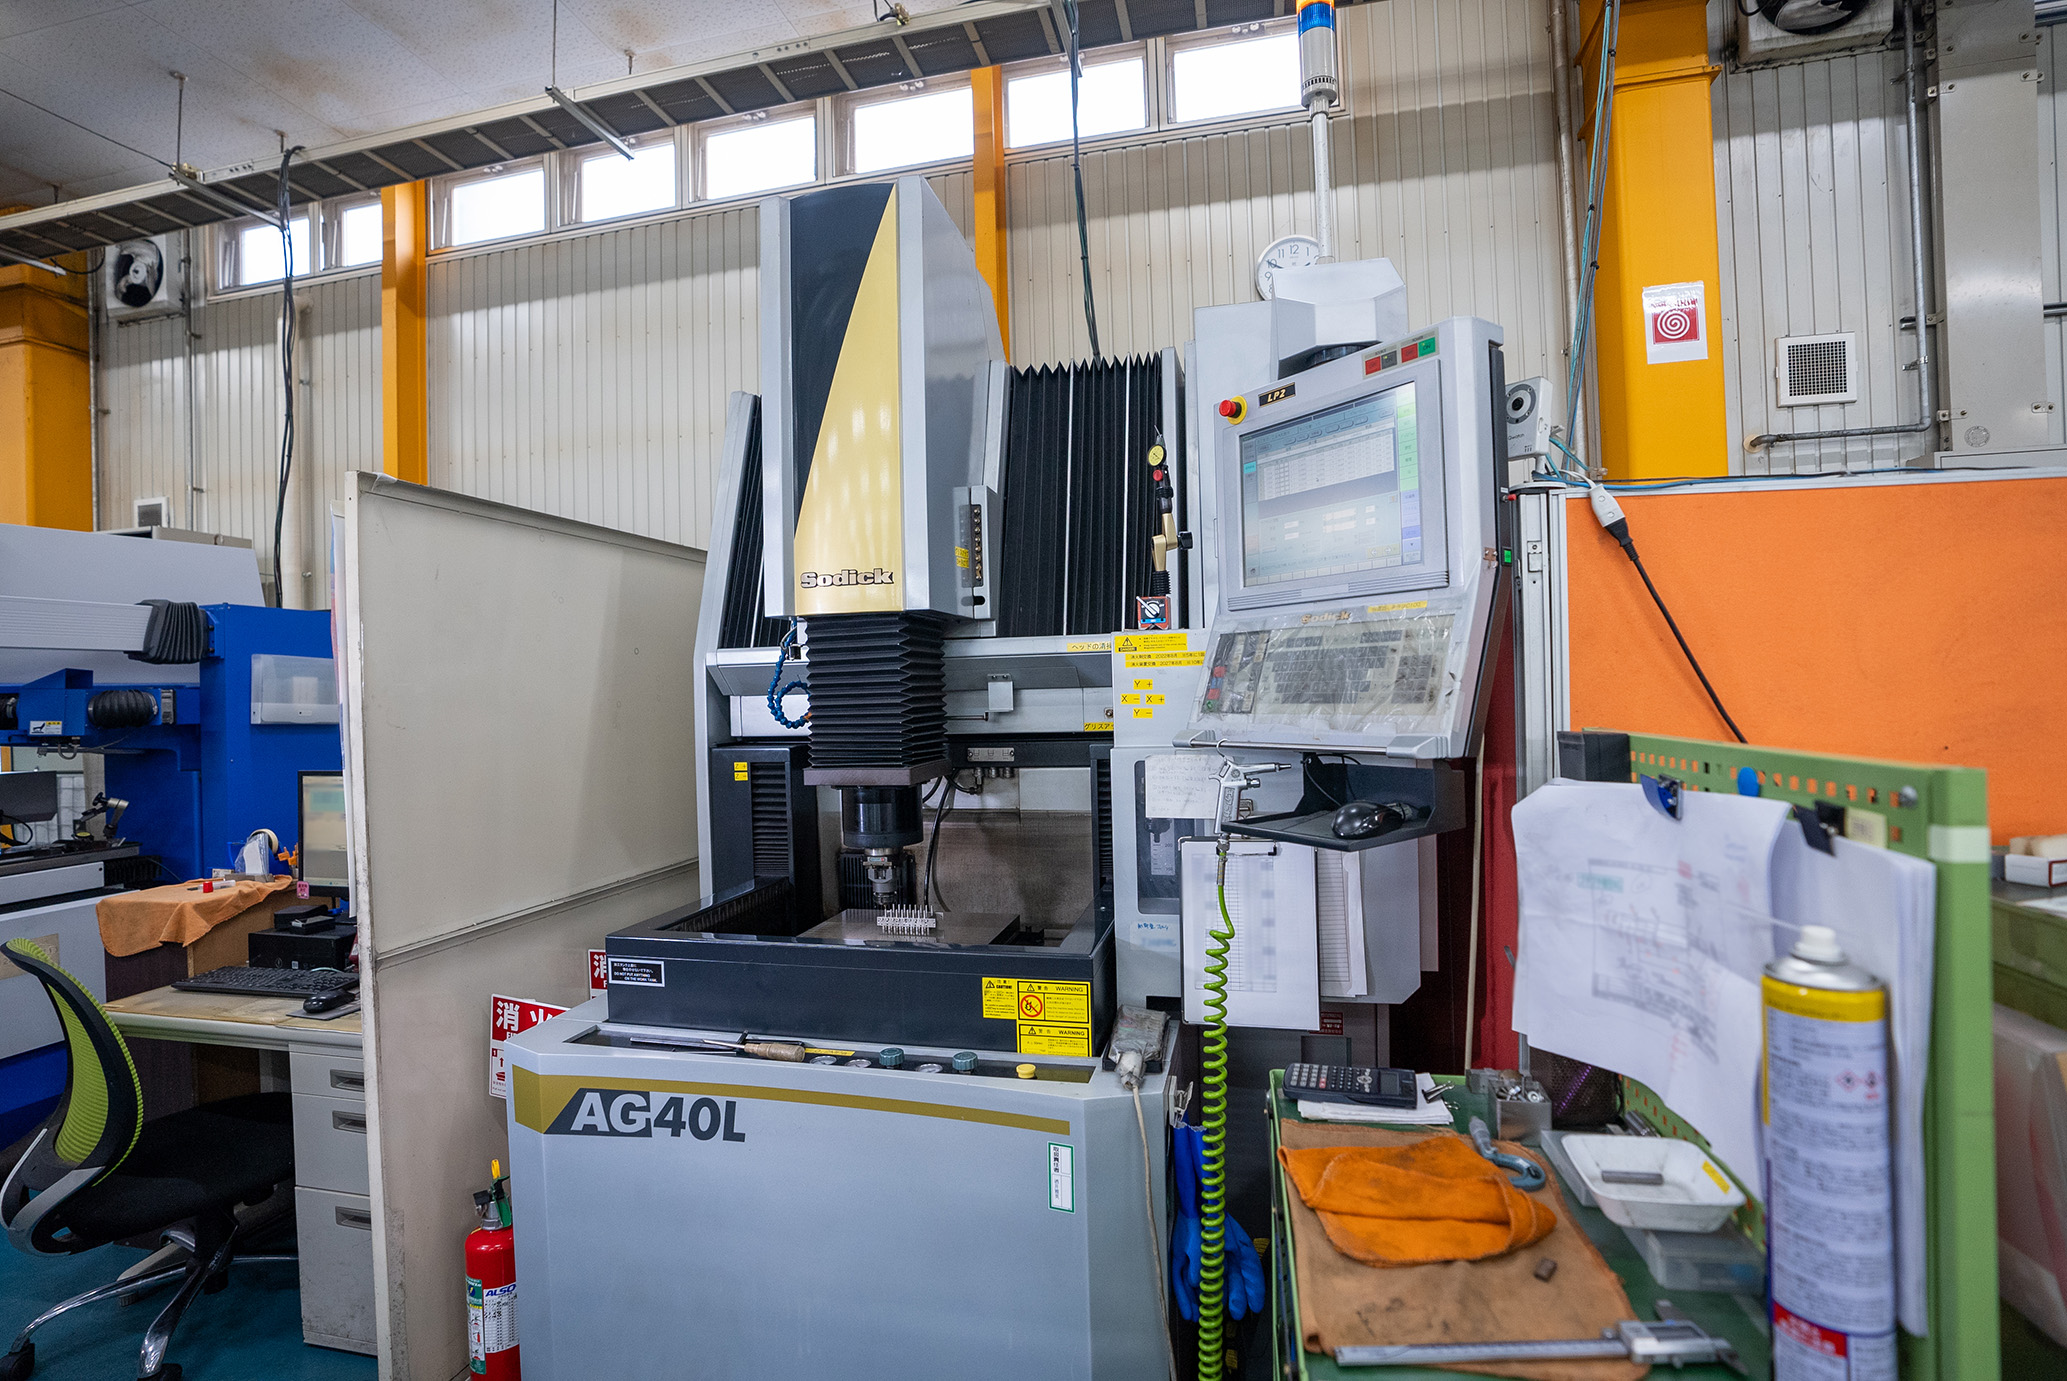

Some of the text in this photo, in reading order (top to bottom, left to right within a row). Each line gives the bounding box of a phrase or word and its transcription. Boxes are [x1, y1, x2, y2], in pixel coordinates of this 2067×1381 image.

[1278, 248, 1285, 259] 11
[1289, 243, 1299, 255] 12
[1306, 246, 1310, 257] 1
[1264, 271, 1273, 281] 9
[1267, 388, 1287, 403] LP2
[800, 568, 894, 588] Sodick
[1300, 610, 1351, 625] Sodick
[570, 1092, 746, 1142] AG40L
[485, 1284, 517, 1297] ALSO
